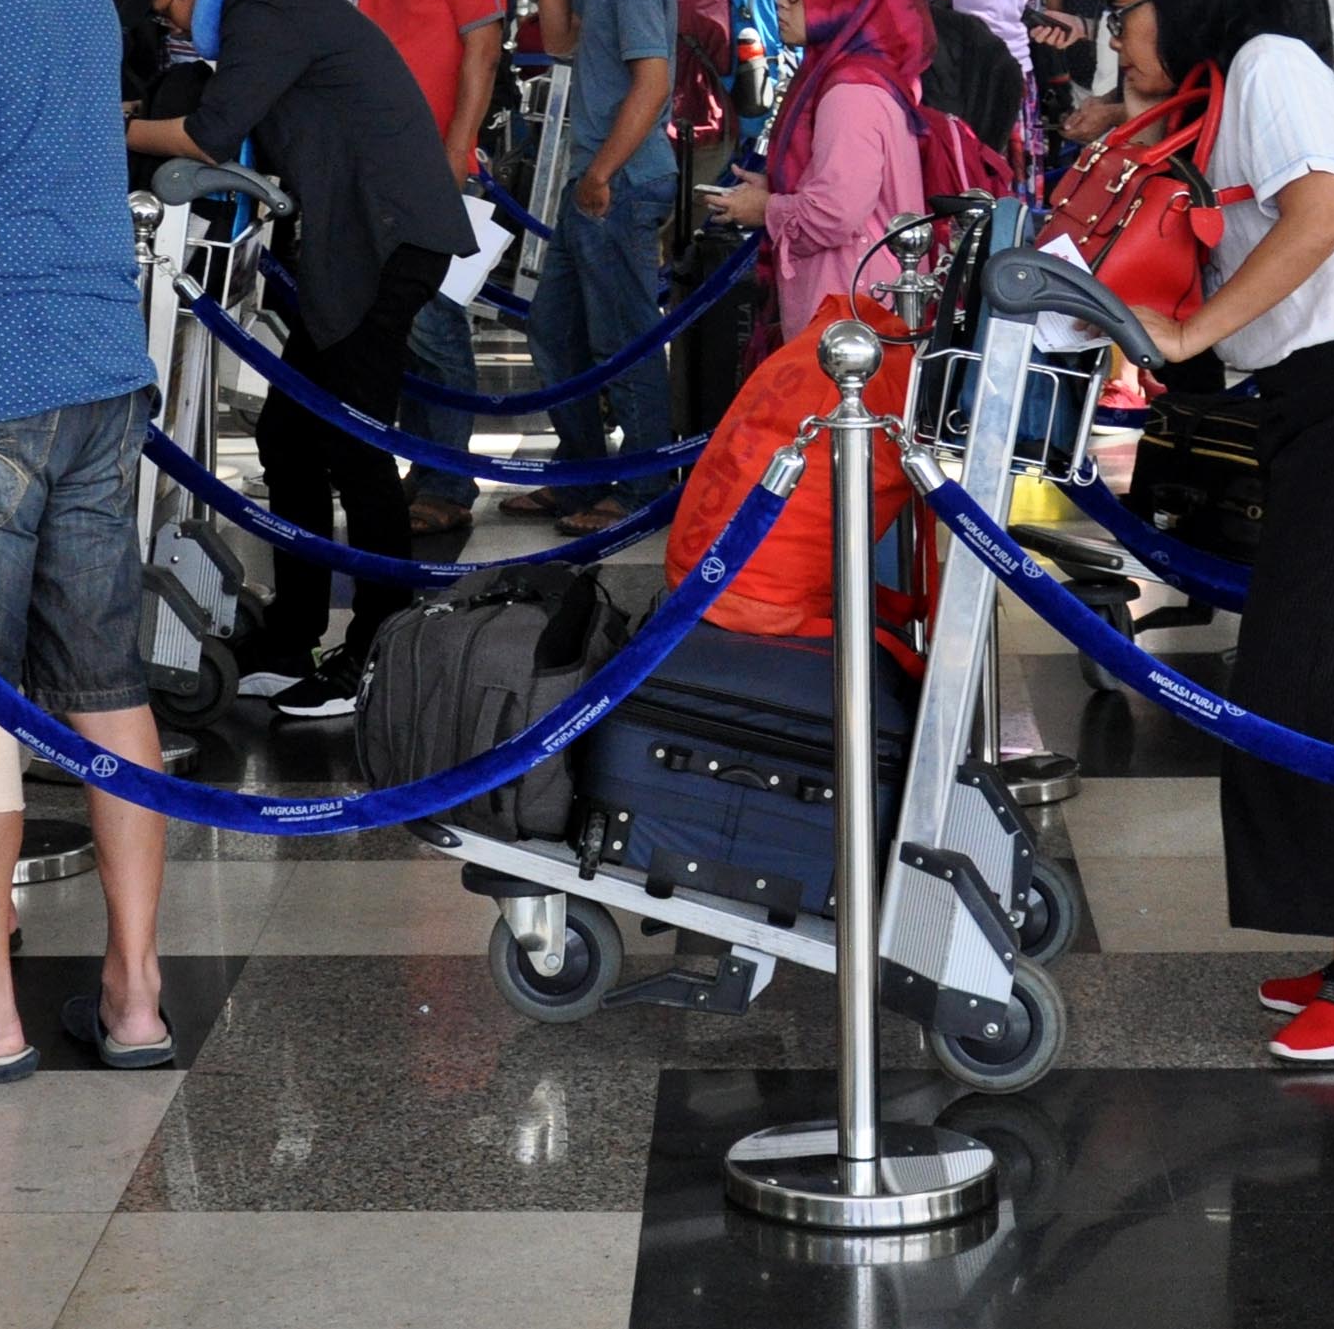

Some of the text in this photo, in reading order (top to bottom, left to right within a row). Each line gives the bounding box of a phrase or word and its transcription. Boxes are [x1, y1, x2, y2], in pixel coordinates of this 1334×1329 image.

[956, 512, 993, 548] ANGKASA
[990, 543, 1012, 566] PURA
[1147, 670, 1191, 699] ANGKASA
[1189, 692, 1214, 712] PURA
[13, 726, 56, 758] ANGKASA
[55, 752, 83, 773] PURA
[260, 805, 308, 815] ANGKASA
[309, 801, 335, 813] PURA
